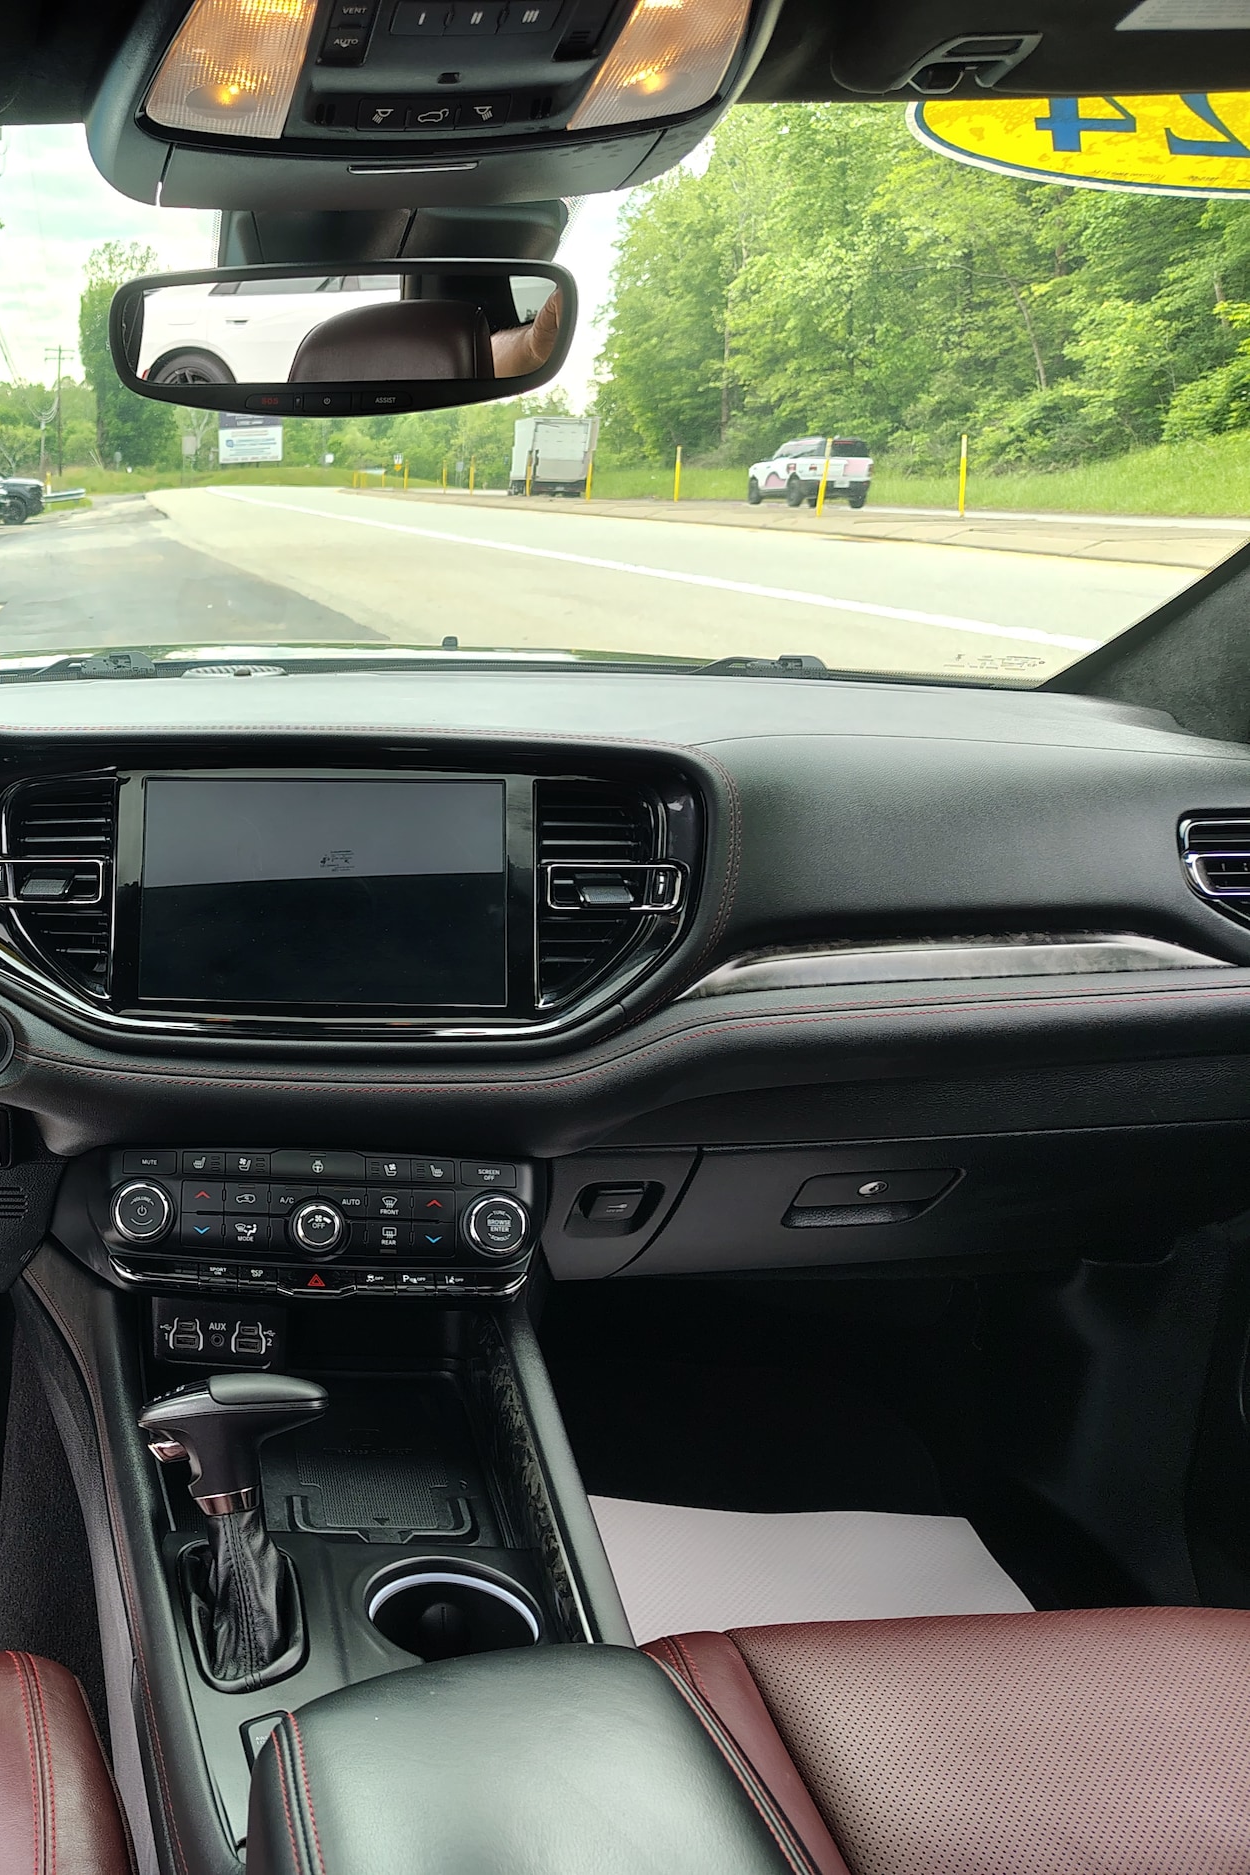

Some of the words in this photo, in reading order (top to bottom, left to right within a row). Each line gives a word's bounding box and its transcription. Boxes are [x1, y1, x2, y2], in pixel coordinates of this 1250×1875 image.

[334, 38, 358, 46] AUTO
[374, 397, 396, 405] ASSIST
[279, 1196, 295, 1205] A/C
[341, 1198, 361, 1206] AUTO
[208, 1322, 228, 1331] AUX
